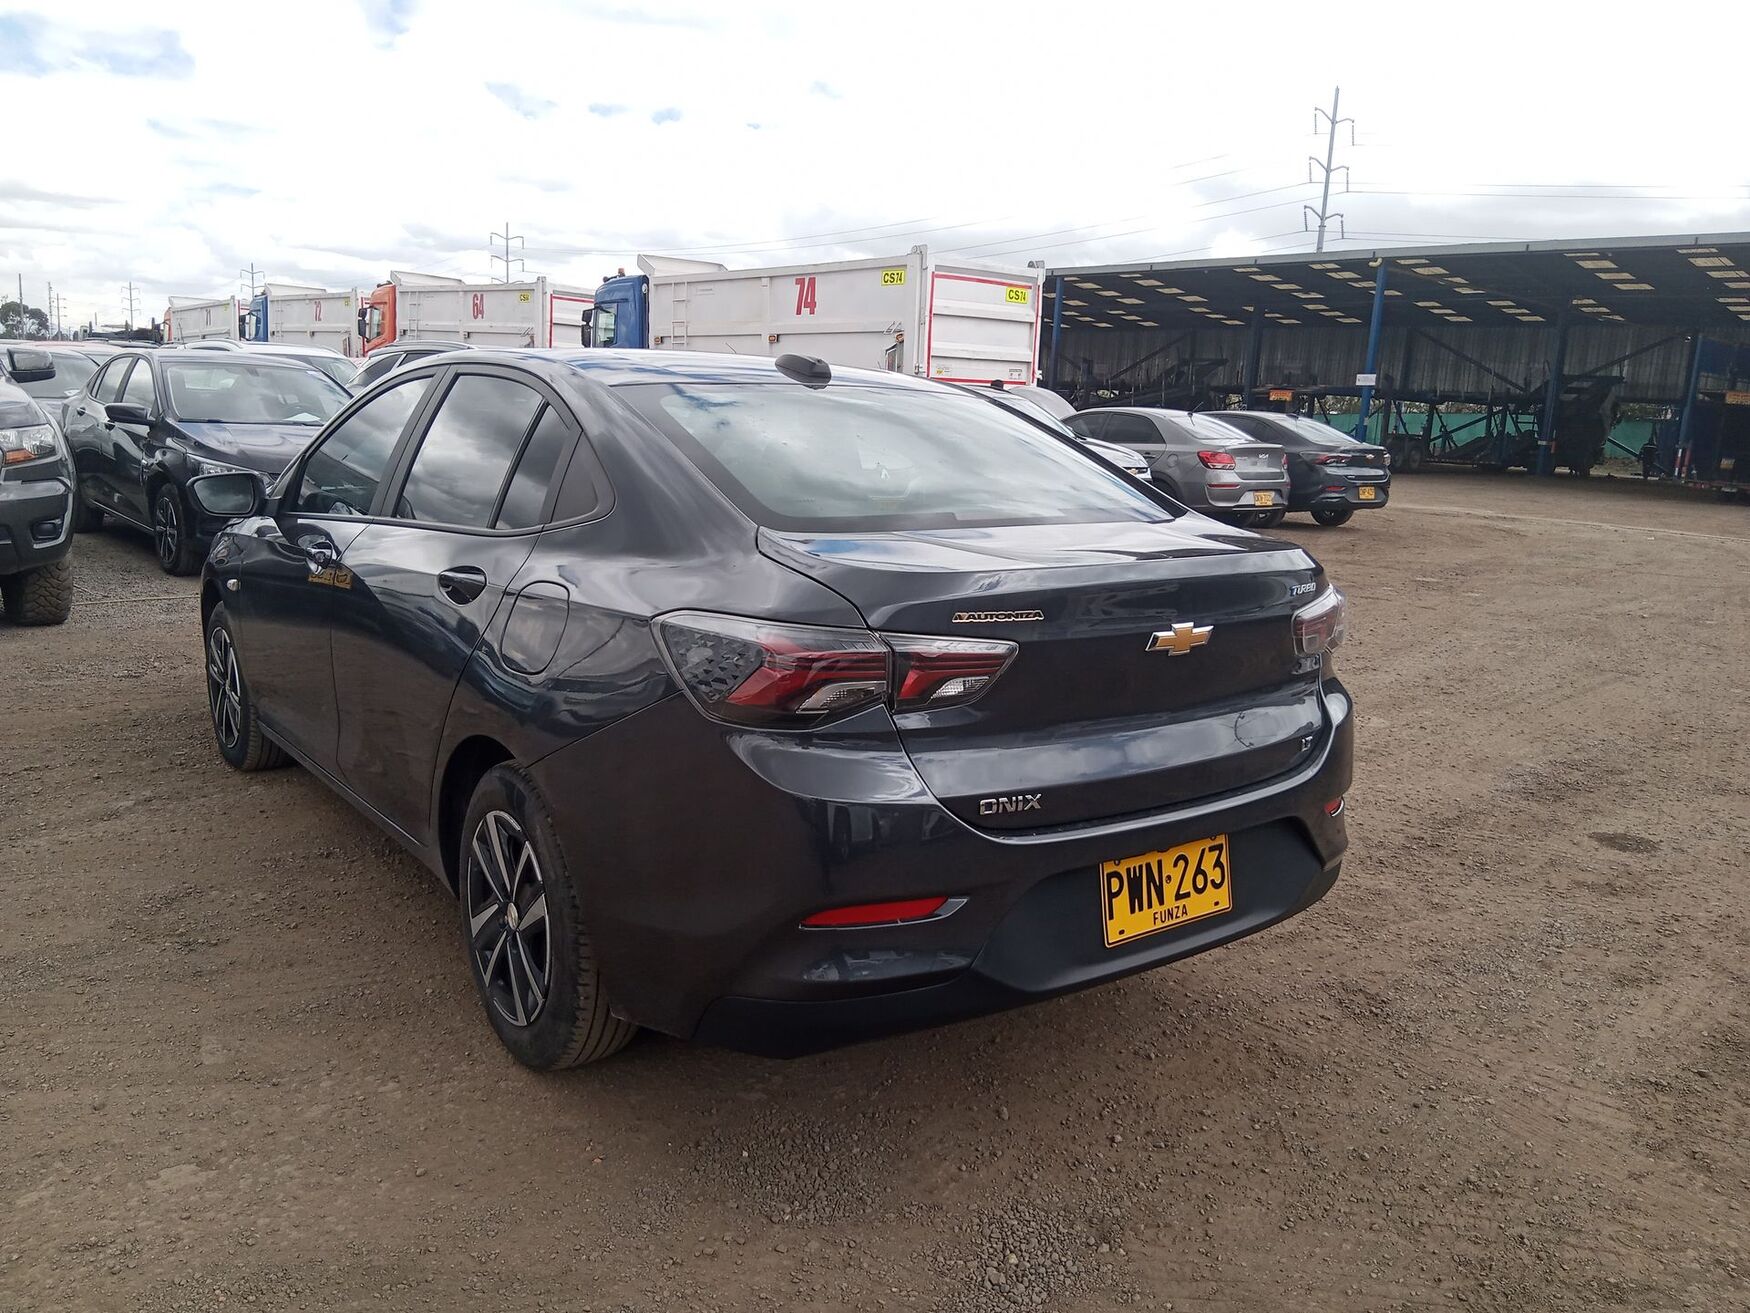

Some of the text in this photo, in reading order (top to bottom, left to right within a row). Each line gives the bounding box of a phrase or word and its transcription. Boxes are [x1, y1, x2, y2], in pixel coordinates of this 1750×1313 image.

[883, 271, 903, 284] CS74
[795, 276, 817, 316] 74
[1008, 288, 1026, 302] CS74
[472, 293, 485, 320] 64
[1289, 582, 1317, 597] TURBO
[965, 610, 1045, 622] AUTONIZA
[979, 793, 1042, 815] ONIX
[1153, 905, 1188, 926] FUNZA
